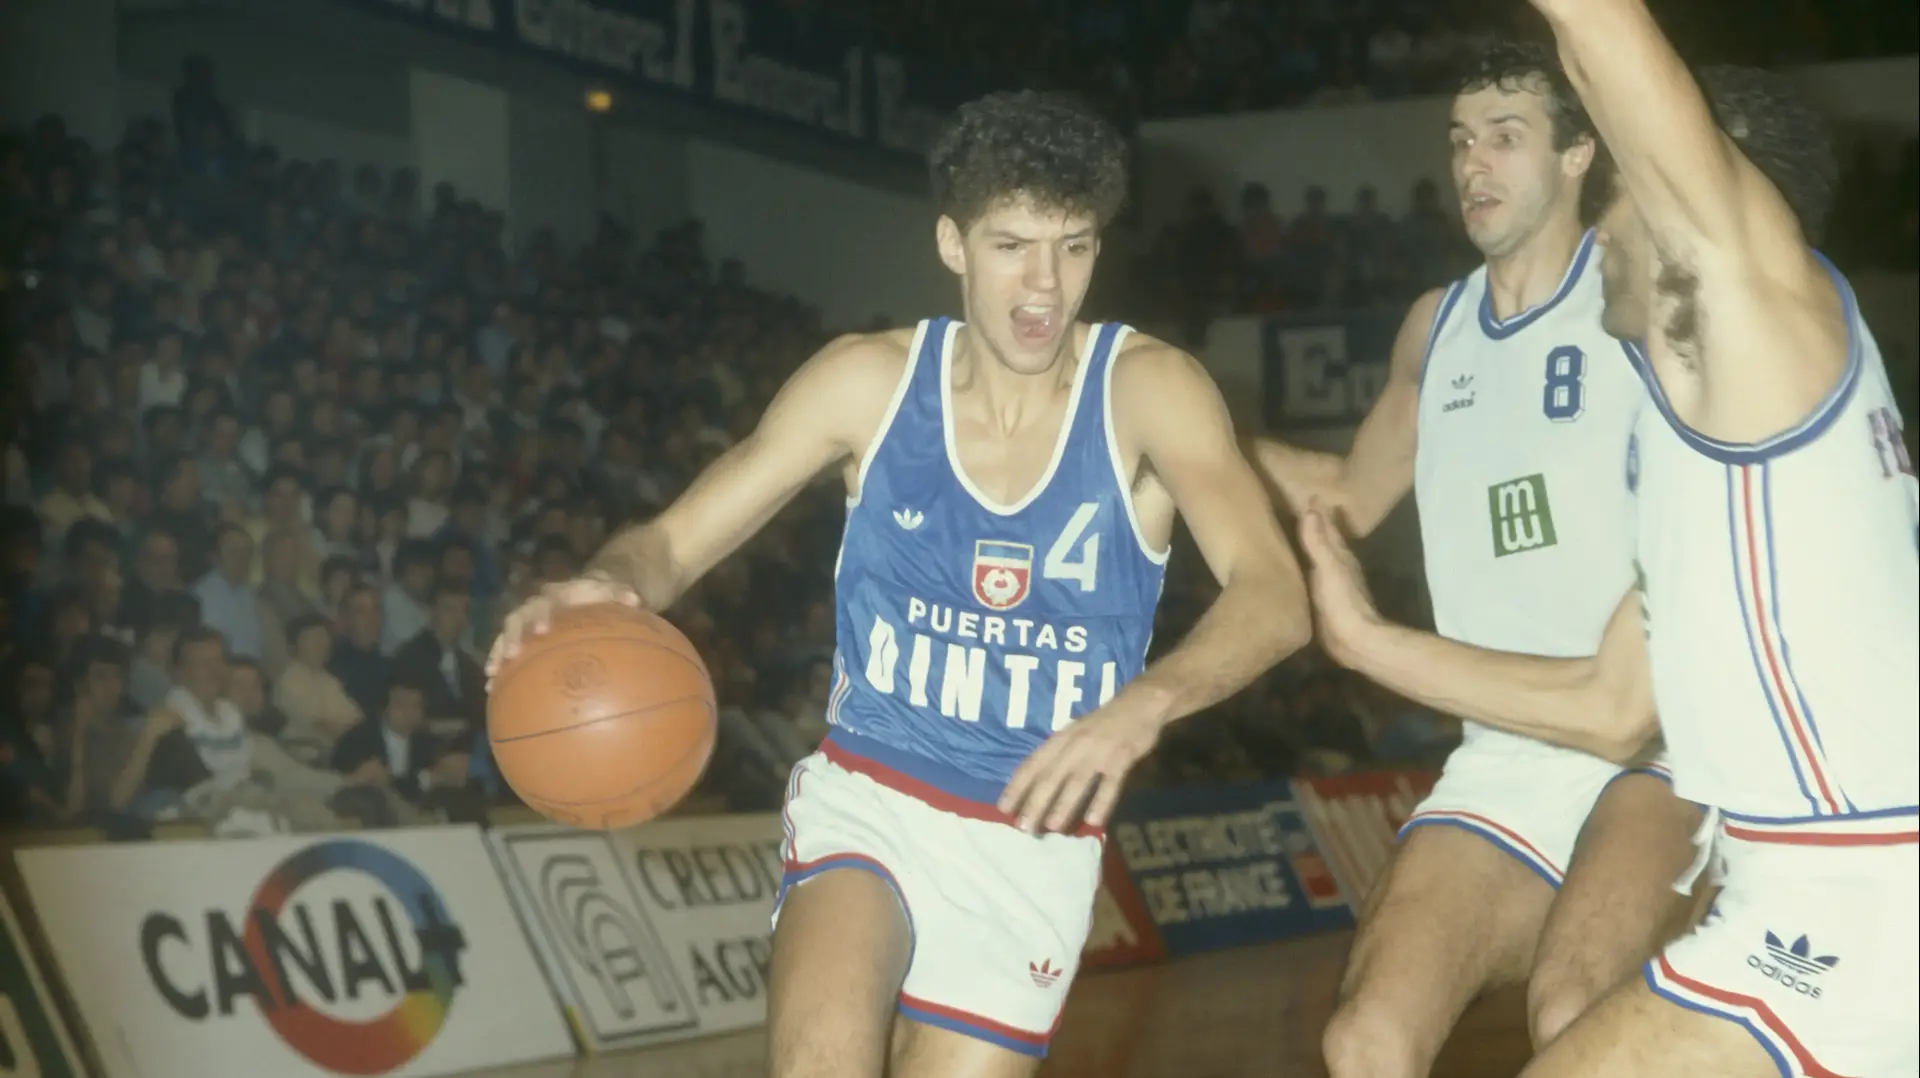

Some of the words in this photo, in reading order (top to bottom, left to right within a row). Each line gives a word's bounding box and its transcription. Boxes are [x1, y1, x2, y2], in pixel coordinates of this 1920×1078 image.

[1543, 344, 1588, 424] 8
[1043, 502, 1100, 592] 4
[908, 597, 1087, 653] PUERTAS
[1139, 874, 1190, 925] DE
[1182, 861, 1291, 918] FRANCE
[1746, 954, 1823, 999] adidas
